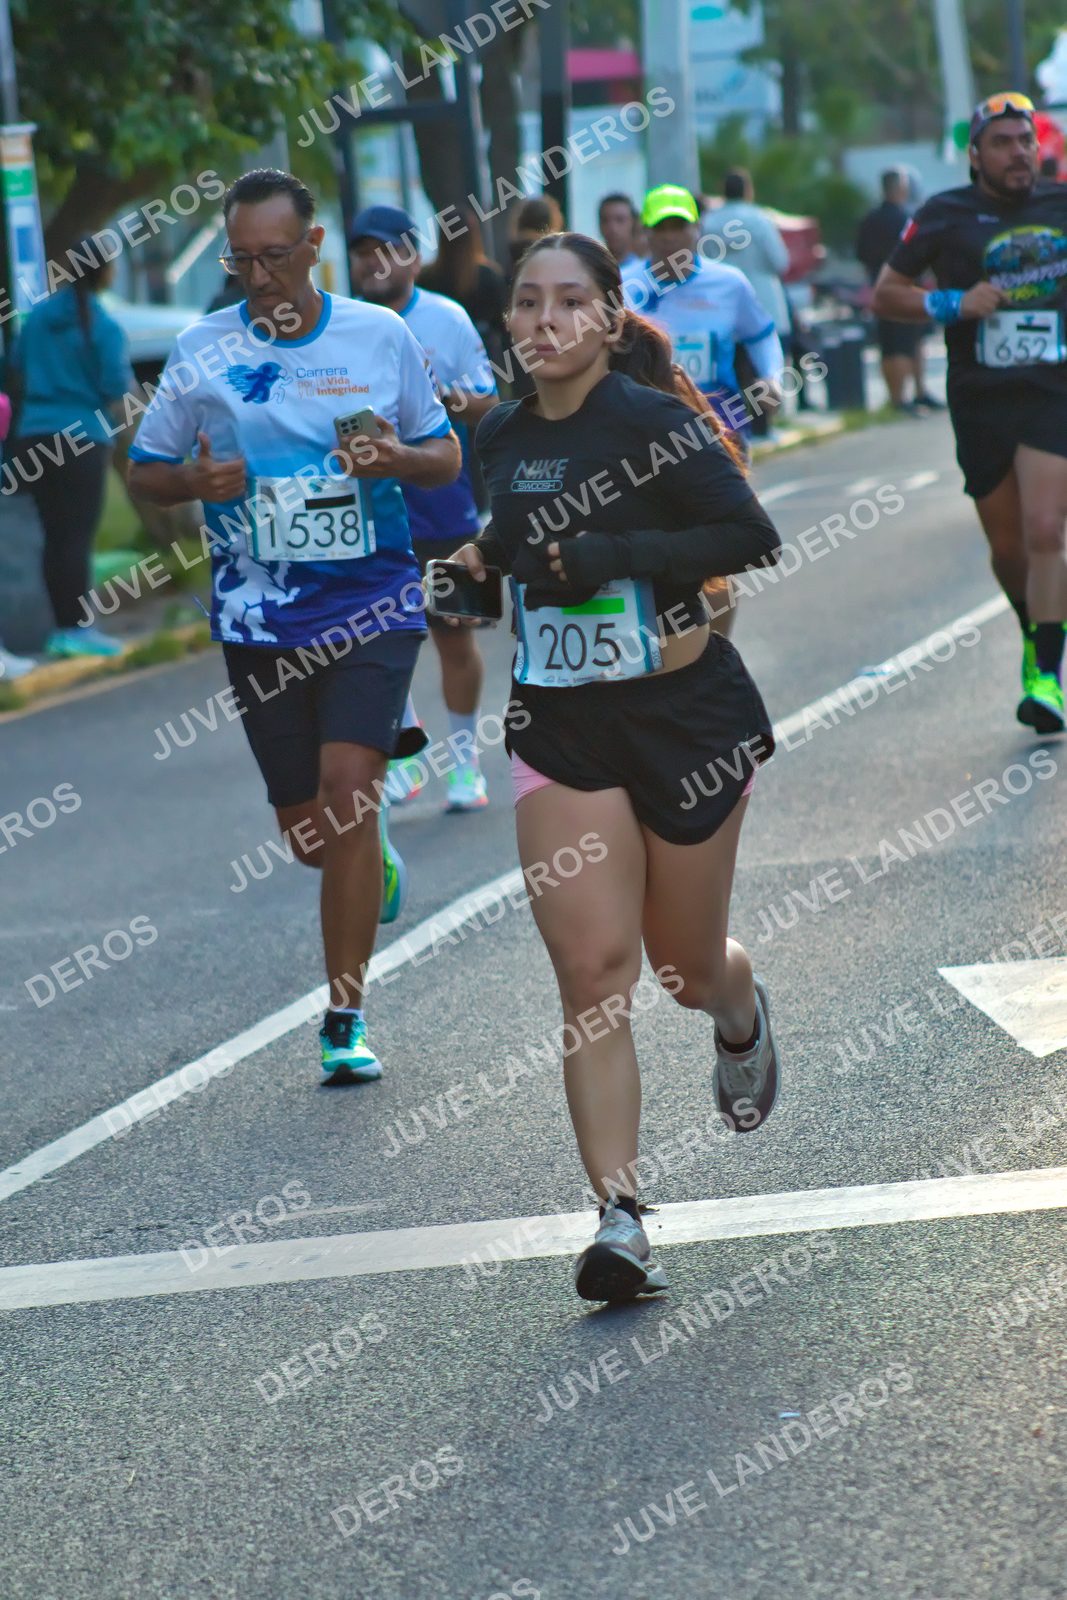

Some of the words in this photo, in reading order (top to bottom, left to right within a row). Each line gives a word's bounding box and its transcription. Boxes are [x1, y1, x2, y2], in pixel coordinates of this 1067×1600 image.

[995, 336, 1047, 362] 652
[296, 367, 348, 378] Carrera
[327, 376, 350, 385] Vida
[317, 384, 369, 396] Integridad
[513, 458, 569, 480] NIKE
[264, 510, 360, 549] 1538
[539, 622, 621, 671] 205
